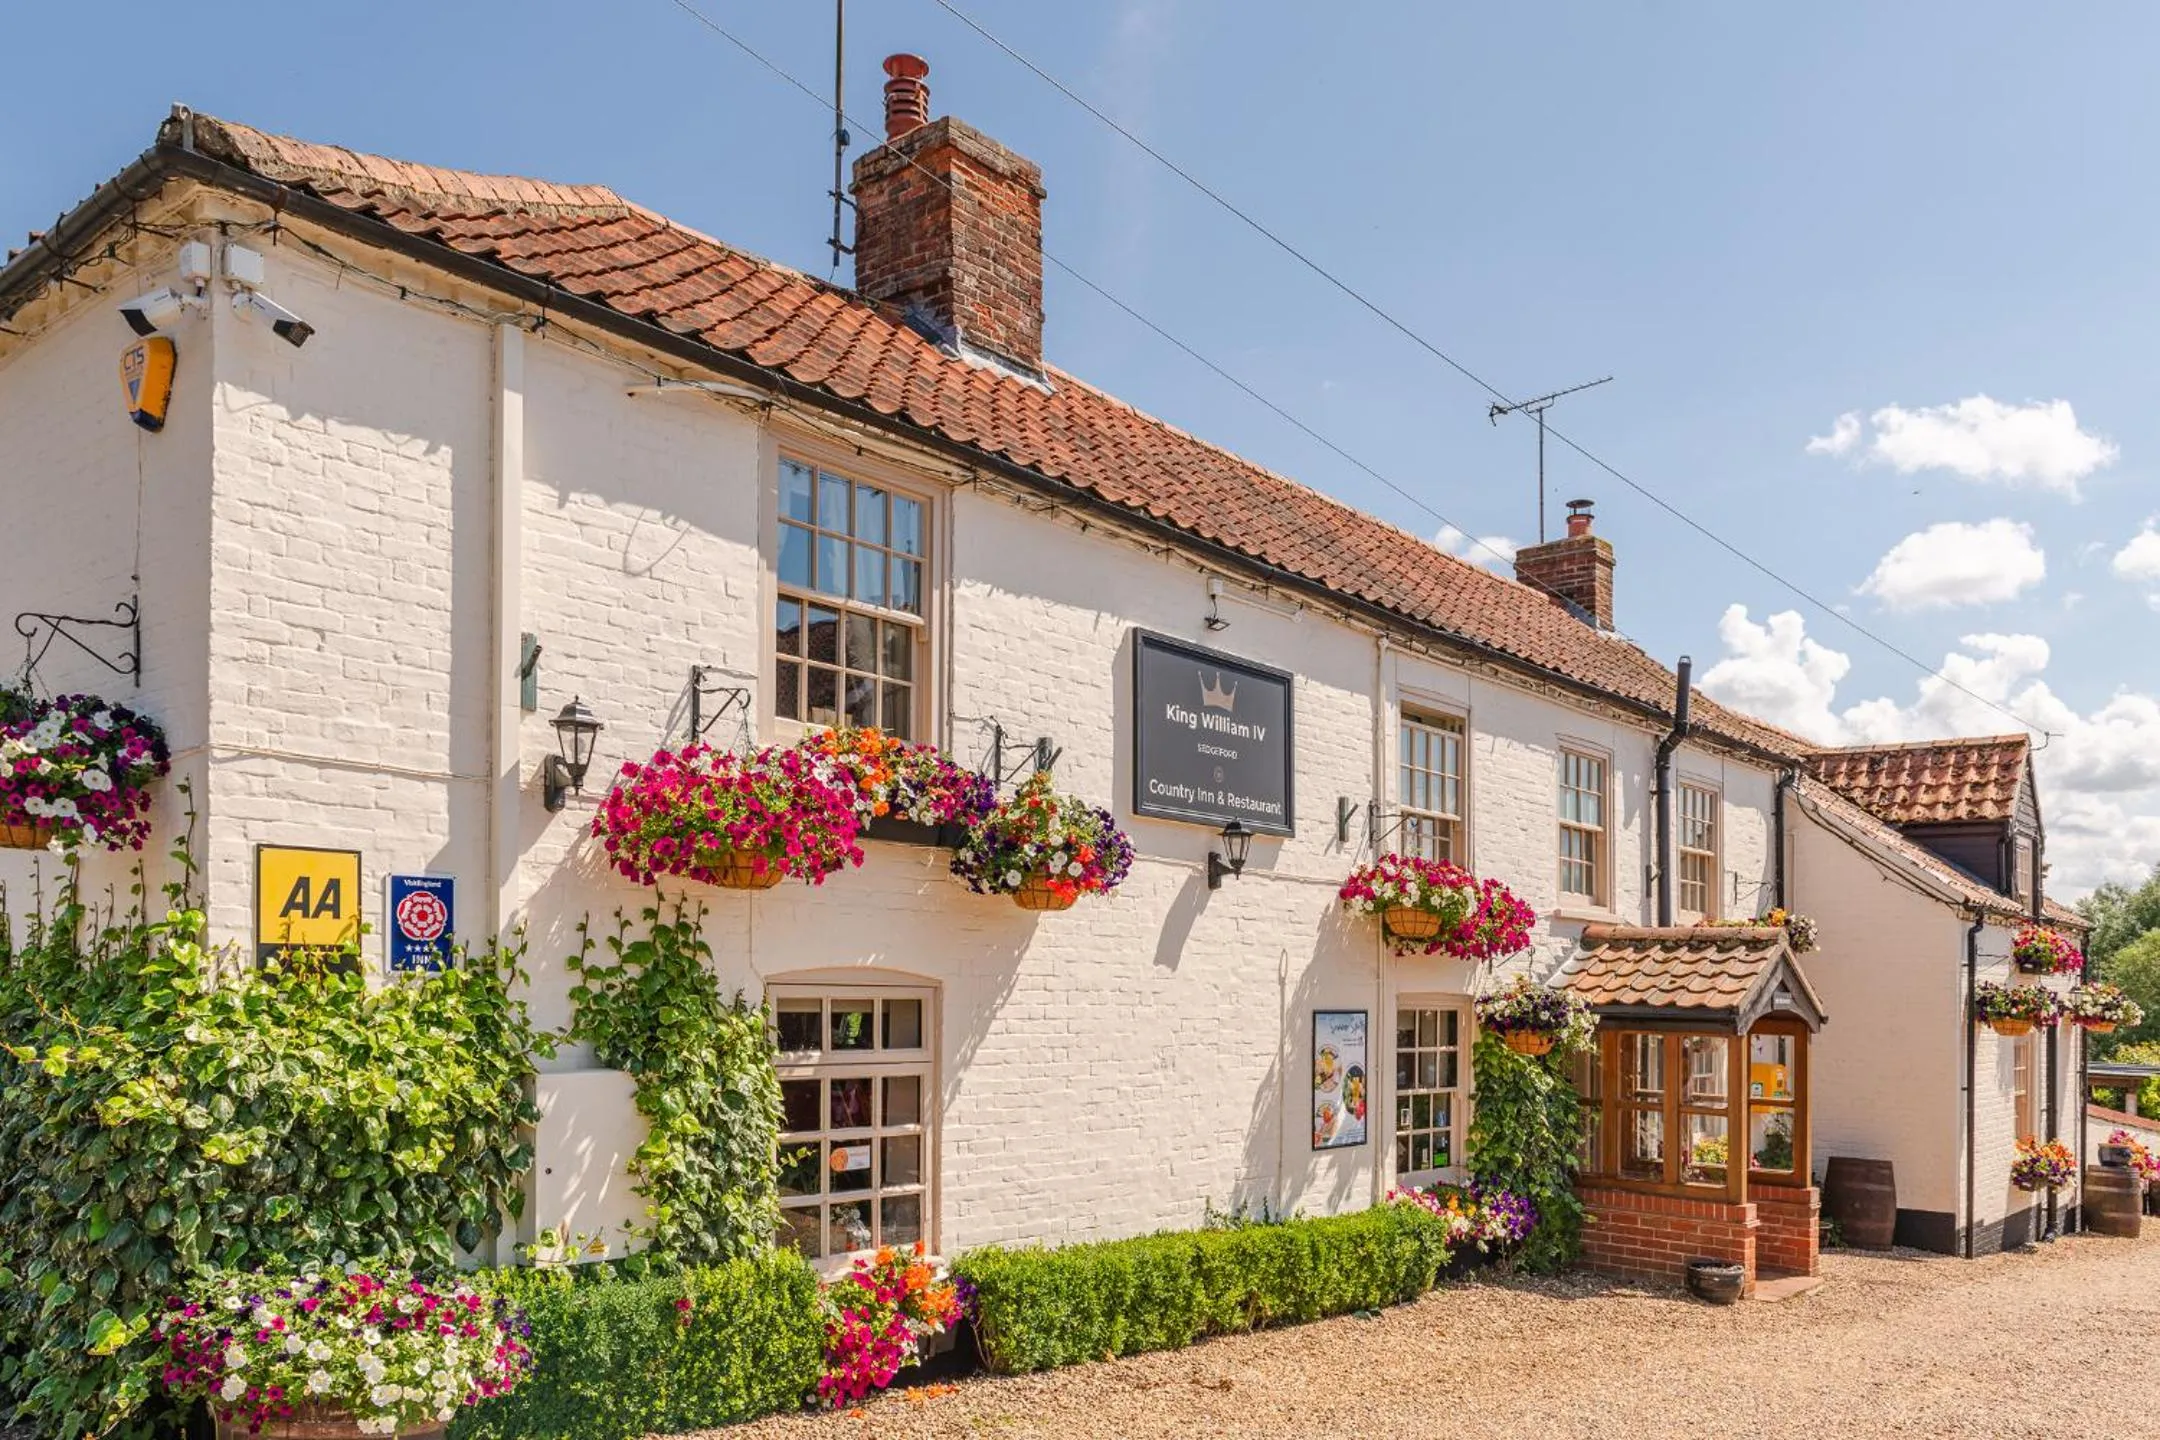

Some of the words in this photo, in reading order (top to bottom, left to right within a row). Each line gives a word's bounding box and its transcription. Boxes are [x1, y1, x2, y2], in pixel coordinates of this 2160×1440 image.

[1166, 703, 1198, 730] King
[1201, 712, 1250, 739] William
[1253, 725, 1266, 741] IV
[1197, 743, 1238, 760] SEDGEFORD
[1149, 779, 1196, 803] Country
[1197, 787, 1215, 804] Inn
[1217, 790, 1226, 806] &
[1227, 792, 1282, 815] Restaurant
[279, 875, 341, 920] AA
